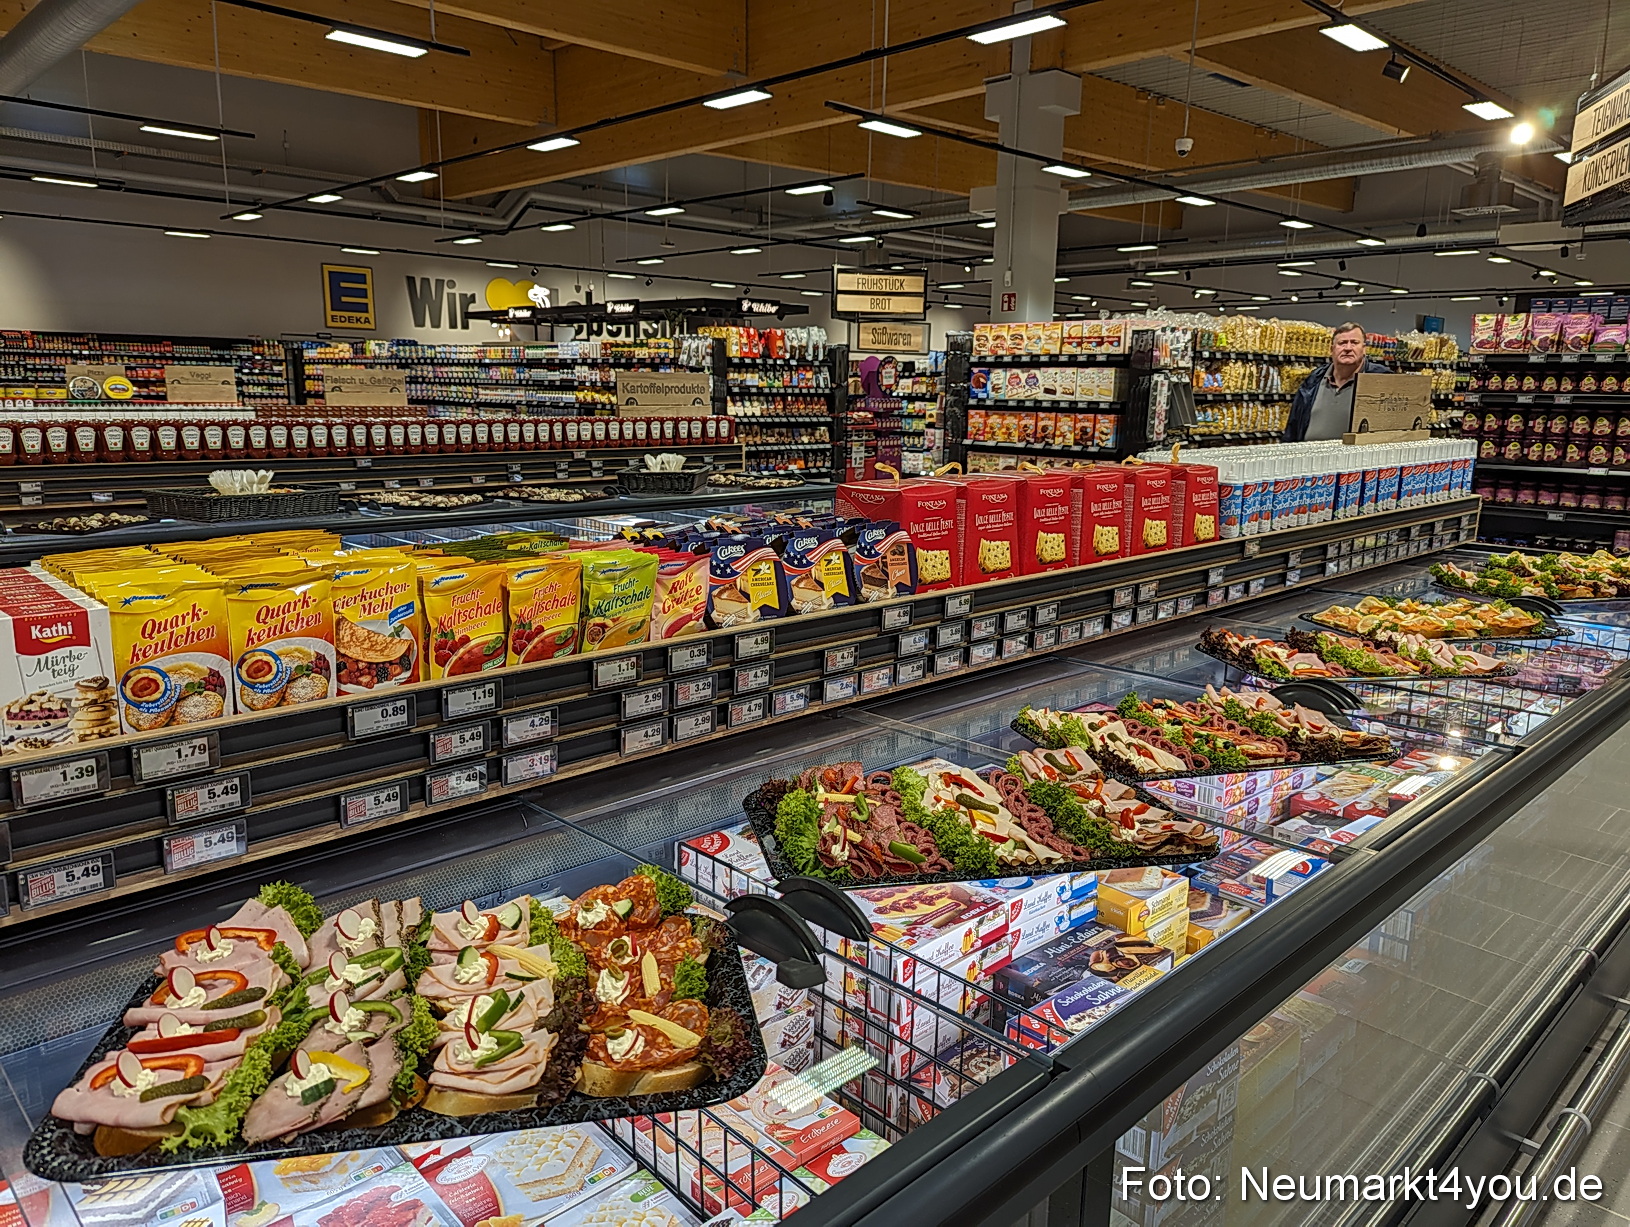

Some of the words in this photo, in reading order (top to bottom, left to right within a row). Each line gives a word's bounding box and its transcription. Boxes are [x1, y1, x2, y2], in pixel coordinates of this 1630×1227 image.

[1591, 89, 1630, 138] TEIGWAR
[856, 274, 906, 290] FRÜHSTÜCK
[406, 275, 476, 330] Wir
[751, 302, 779, 314] Tchibo
[870, 298, 891, 310] BROT
[331, 315, 372, 325] EDEKA
[871, 326, 912, 346] Süßwaren
[325, 376, 356, 384] Fleisch
[621, 382, 706, 396] Kartoffelprodukte
[851, 492, 885, 503] FONTANA
[918, 500, 946, 508] FONTANA
[982, 494, 1008, 502] FONTANA
[910, 522, 924, 534] DOLCE
[926, 520, 939, 531] DELLE
[940, 518, 954, 530] FESTE
[794, 536, 818, 551] Cakees
[864, 530, 886, 542] Cakees
[717, 544, 745, 560] Cakees
[533, 582, 562, 600] Frucht-
[613, 579, 639, 594] Frucht-
[668, 572, 694, 595] Rote
[333, 581, 411, 613] Eierkuchen-
[452, 589, 485, 607] Frucht-
[595, 585, 652, 615] Kaltschale
[662, 585, 703, 615] Grütze
[255, 591, 318, 625] Quark-
[358, 596, 394, 618] Mehl
[518, 591, 577, 624] Kaltschale
[140, 603, 209, 639] Quark-
[437, 598, 503, 633] Kaltschale
[30, 621, 73, 639] Kathi
[246, 610, 322, 648] keulchen
[455, 620, 488, 635] Himbeere
[129, 623, 216, 664] keulchen
[753, 636, 769, 646] 4.99
[689, 648, 706, 658] 0.35
[26, 650, 88, 678] Mürbe-
[617, 662, 635, 673] 1.19
[51, 664, 80, 680] teig
[753, 669, 769, 679] 4.79
[472, 688, 494, 700] 1.19
[694, 682, 711, 693] 3.29
[644, 692, 662, 703] 2.99
[380, 705, 406, 719] 0.89
[746, 703, 762, 713] 4.79
[529, 715, 550, 729] 4.29
[694, 715, 710, 726] 2.99
[458, 731, 482, 745] 5.49
[643, 727, 661, 739] 4.29
[175, 743, 206, 760] 1.79
[528, 755, 550, 767] 3.19
[60, 764, 95, 782] 1.39
[455, 772, 478, 786] 5.49
[207, 783, 238, 799] 5.49
[178, 799, 198, 812] BILLIG
[373, 792, 398, 806] 5.49
[203, 831, 234, 848] 5.49
[174, 848, 194, 862] BILLIG
[65, 864, 100, 882] 5.49
[31, 882, 54, 898] BILLIG
[1151, 893, 1170, 908] Schmand
[960, 906, 987, 919] EDEKA
[1152, 924, 1172, 938] Schmand
[1024, 962, 1046, 976] EDEKA
[1058, 981, 1107, 1007] Schokoladen
[1086, 986, 1126, 1005] Sahne
[1206, 1047, 1239, 1077] Schokoladen
[1217, 1060, 1239, 1084] Sahne
[800, 1117, 842, 1145] Erdbeere
[1201, 1116, 1233, 1147] Schokoladen
[1212, 1128, 1234, 1150] Sahne
[638, 1184, 655, 1197] NEUE
